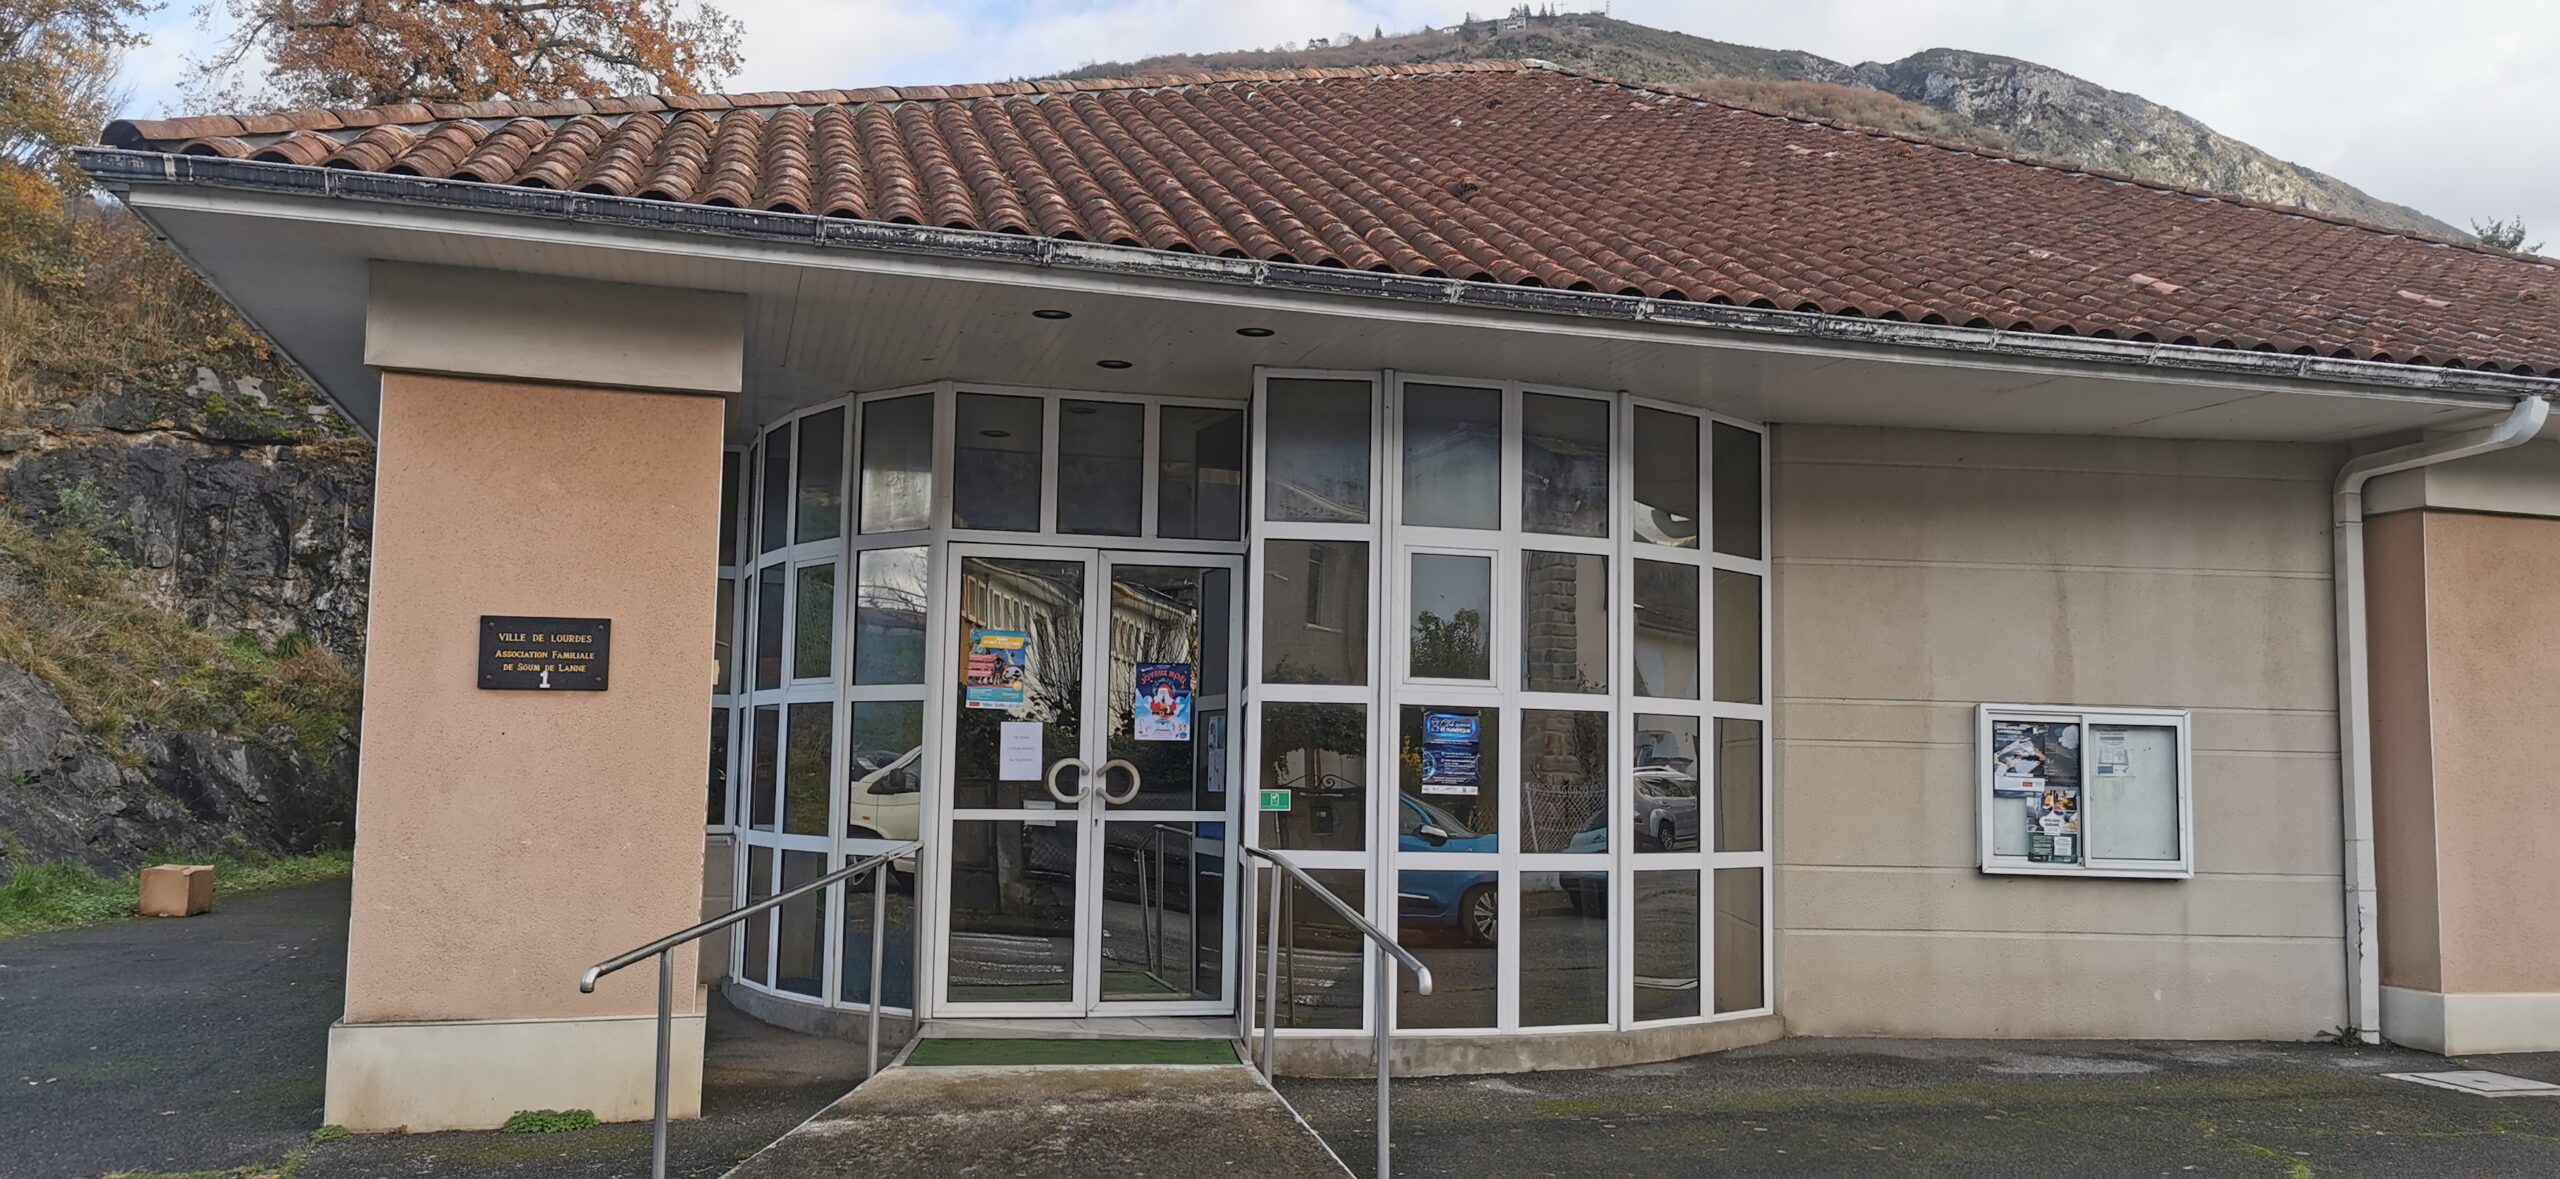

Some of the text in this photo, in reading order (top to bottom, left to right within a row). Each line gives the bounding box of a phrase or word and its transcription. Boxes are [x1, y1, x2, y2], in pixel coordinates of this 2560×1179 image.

[499, 633, 592, 643] VILLE DE LOURDES
[539, 668, 551, 688] 1
